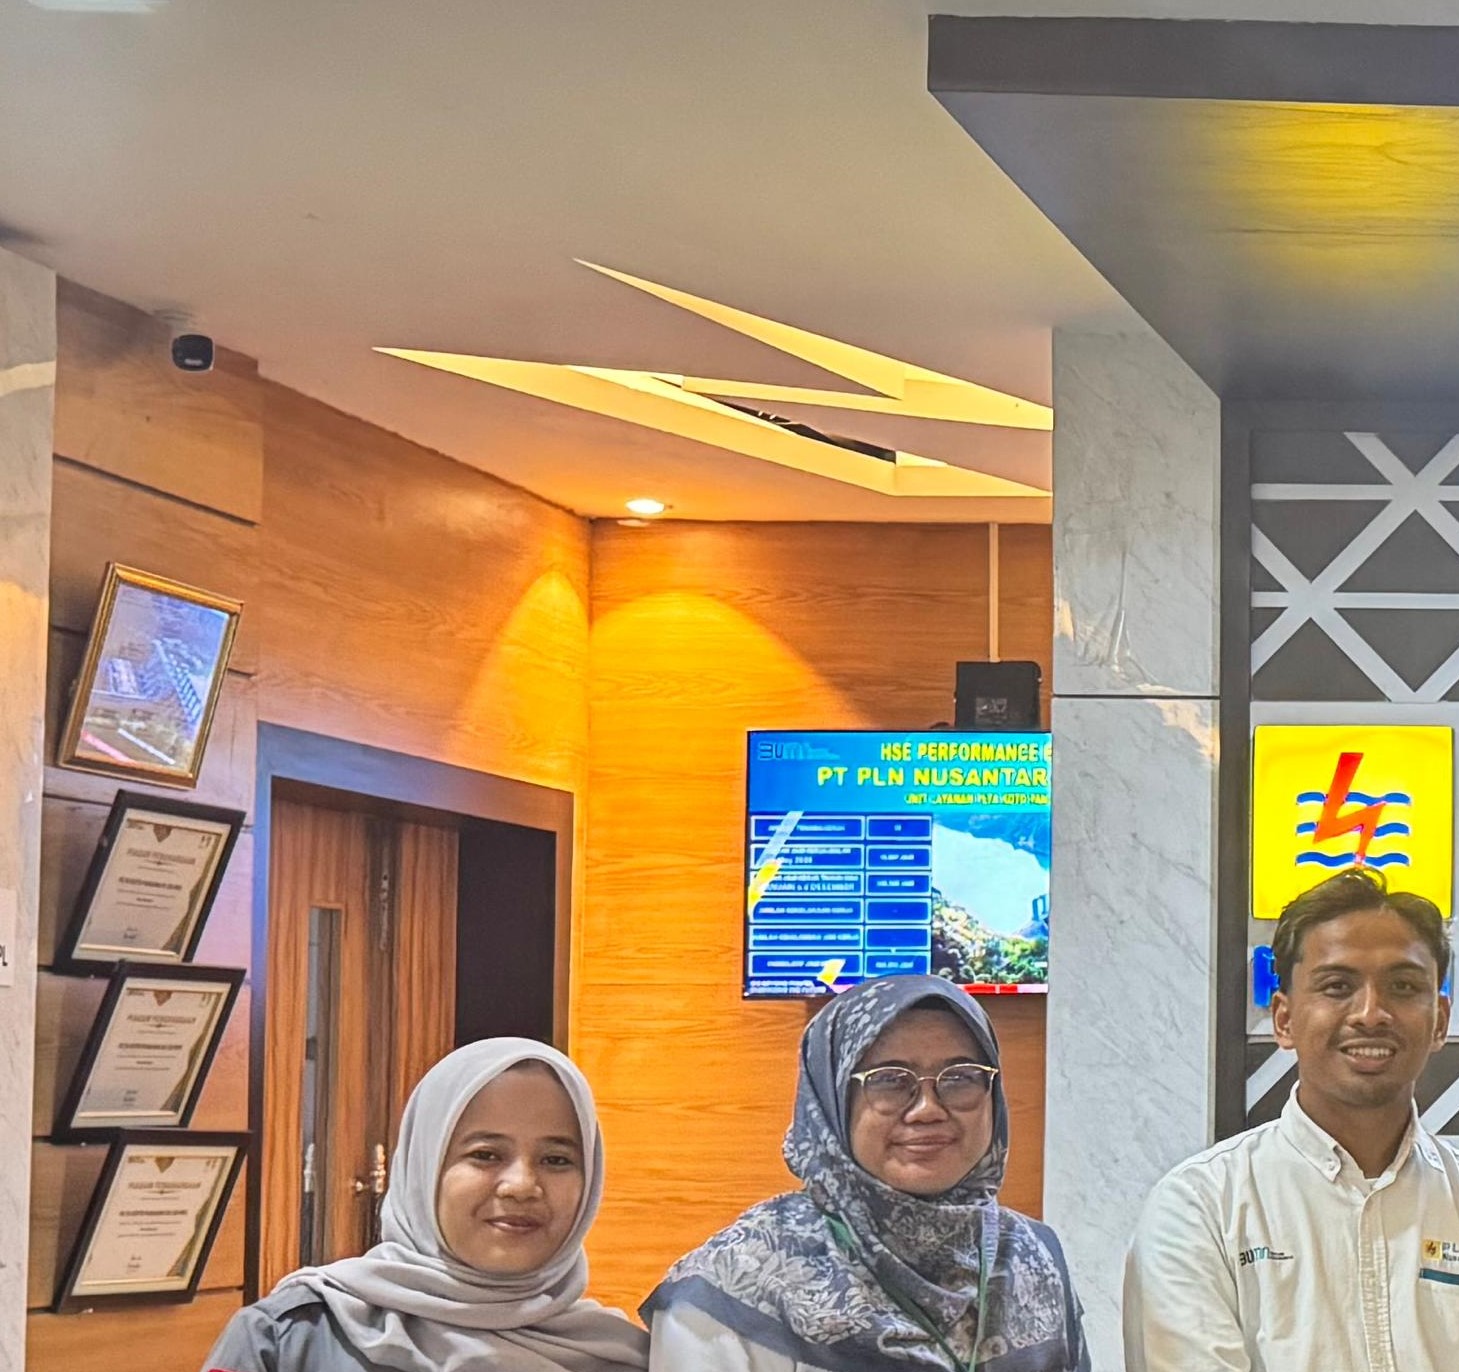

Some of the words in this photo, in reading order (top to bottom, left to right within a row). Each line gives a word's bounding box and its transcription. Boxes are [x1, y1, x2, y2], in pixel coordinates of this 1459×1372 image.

[881, 742, 911, 761] HSE
[917, 742, 1039, 761] PERFORMANCE
[817, 766, 848, 786] PT
[857, 767, 904, 787] PLN
[914, 767, 1048, 787] NUSANTAR
